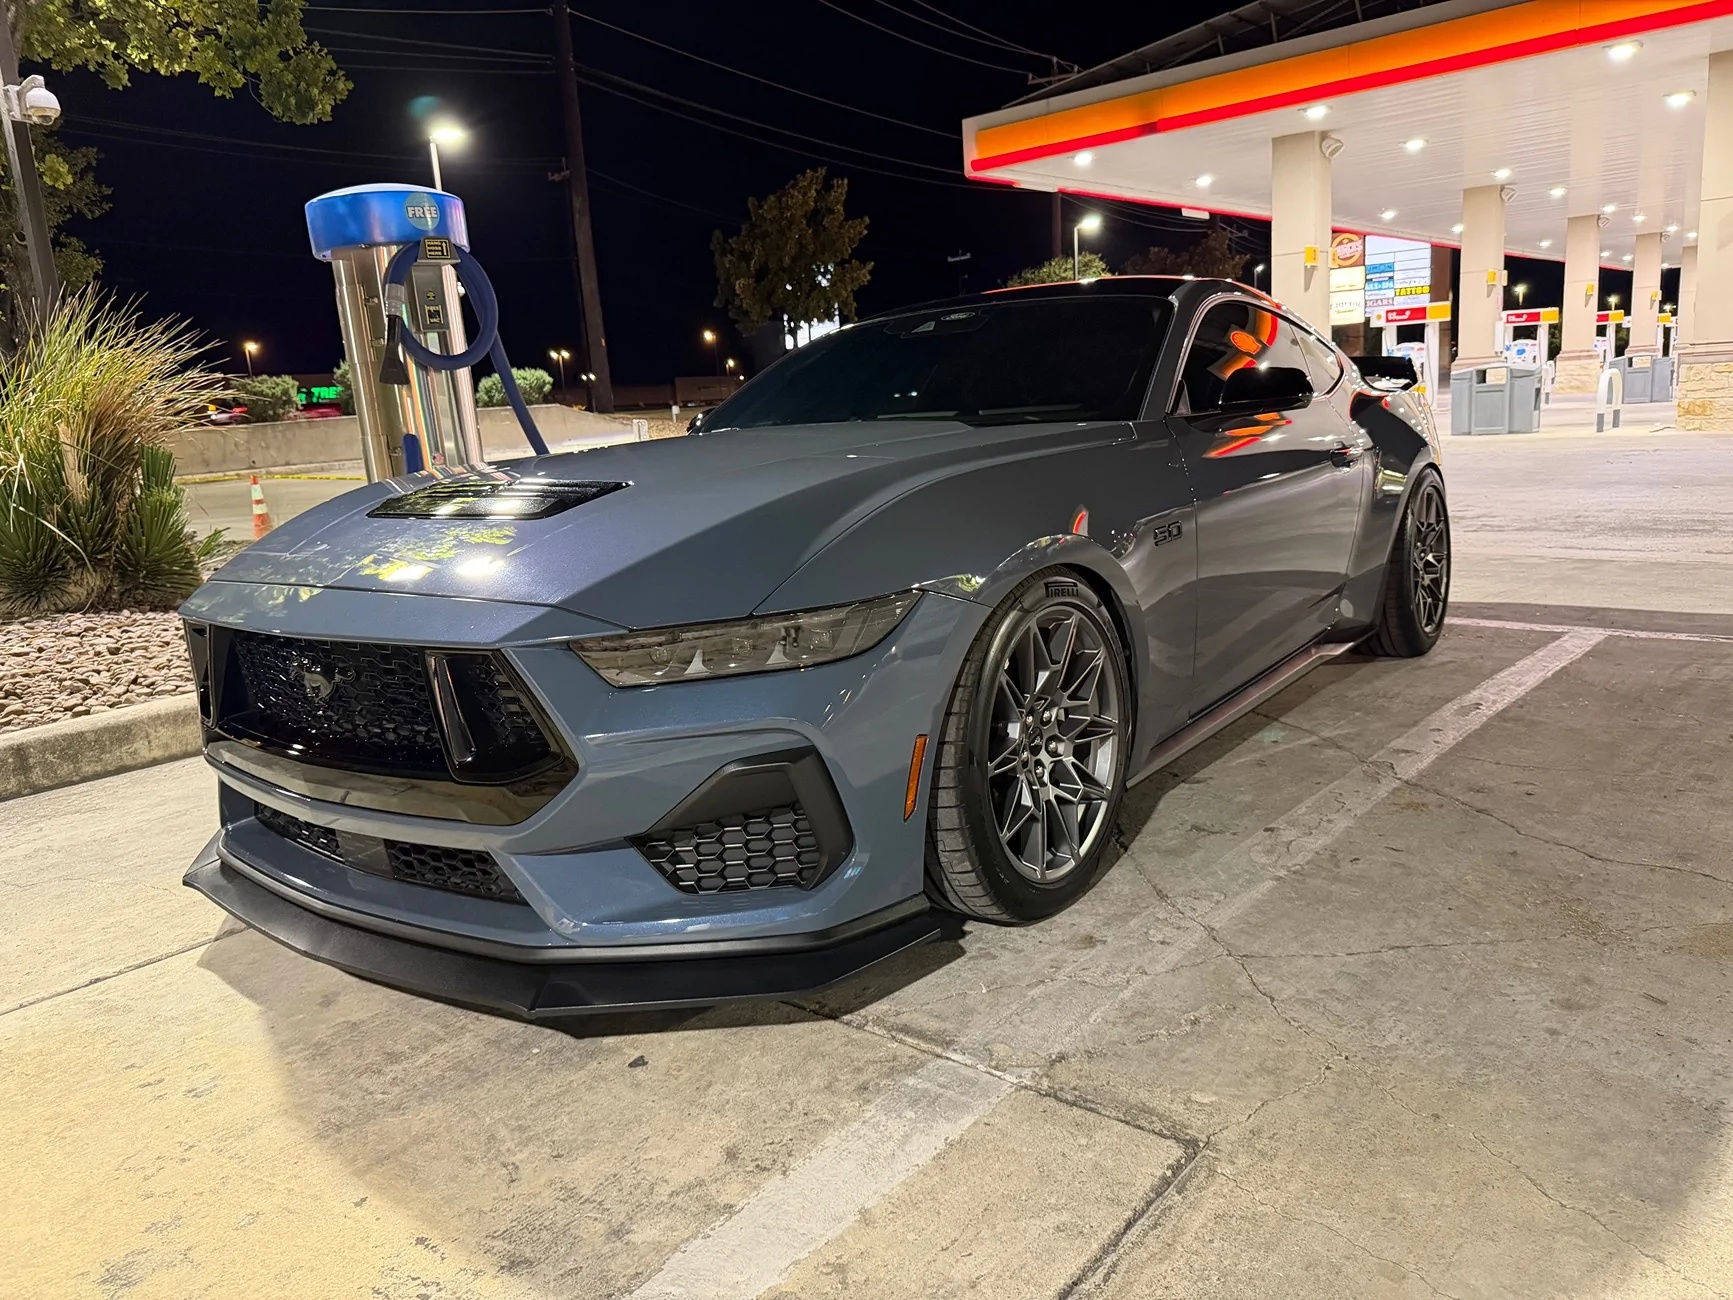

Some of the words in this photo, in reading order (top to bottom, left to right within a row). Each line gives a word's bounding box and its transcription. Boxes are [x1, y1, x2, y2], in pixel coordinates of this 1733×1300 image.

[406, 205, 439, 219] FREE
[1394, 286, 1430, 296] TATTOO
[1044, 581, 1079, 598] PIRELLI
